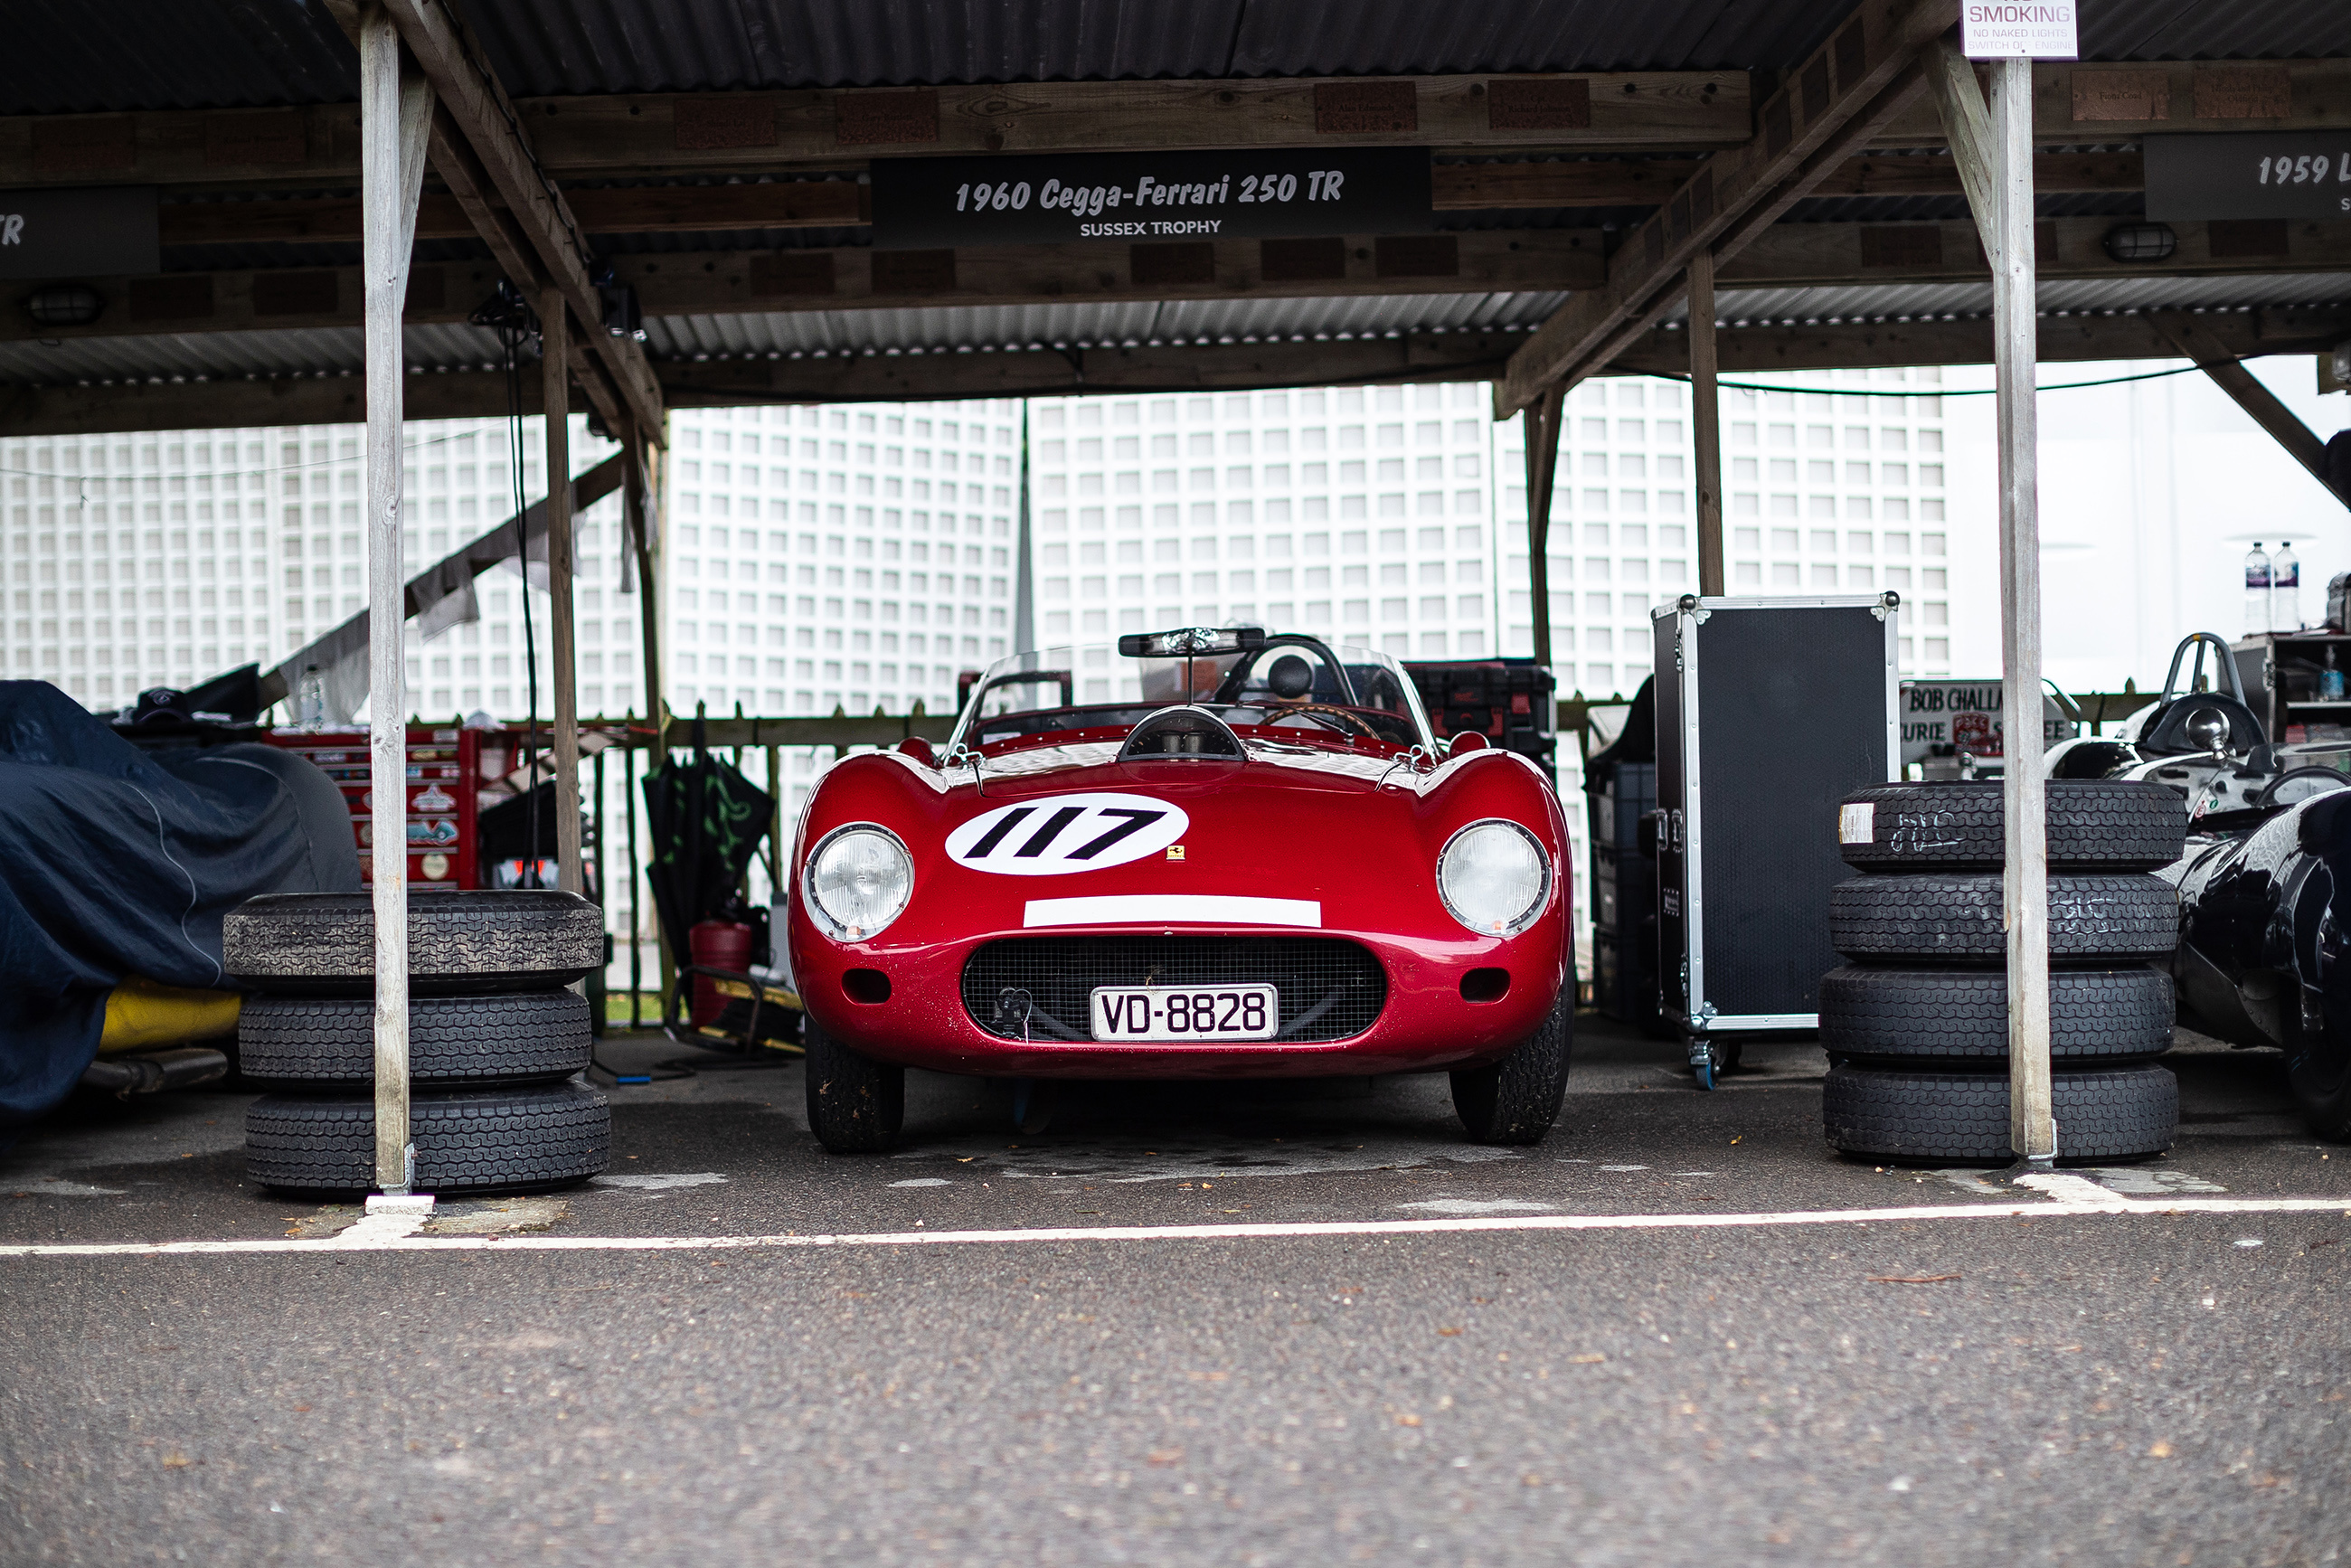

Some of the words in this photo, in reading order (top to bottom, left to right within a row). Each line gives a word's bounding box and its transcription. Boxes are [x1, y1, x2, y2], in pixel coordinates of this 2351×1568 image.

[1969, 5, 2070, 23] SMOKING
[1973, 28, 1989, 37] NO
[1992, 28, 2029, 37] NAKED
[2032, 28, 2068, 37] LIGHTS
[1968, 41, 2009, 50] SWITCH
[2035, 41, 2073, 50] ENGINE
[2260, 155, 2329, 184] 1959
[955, 181, 1031, 213] 1960
[1039, 174, 1231, 217] Cegga-Ferrari
[1237, 174, 1298, 203] 250
[1308, 170, 1345, 202] TR
[0, 213, 24, 245] R
[1080, 222, 1147, 237] SUSSEX
[1150, 220, 1223, 235] TROPHY
[1910, 687, 1944, 712] BOB
[1901, 722, 1946, 741] URIE
[963, 807, 1168, 860] 117
[1101, 992, 1266, 1034] VD-8828
